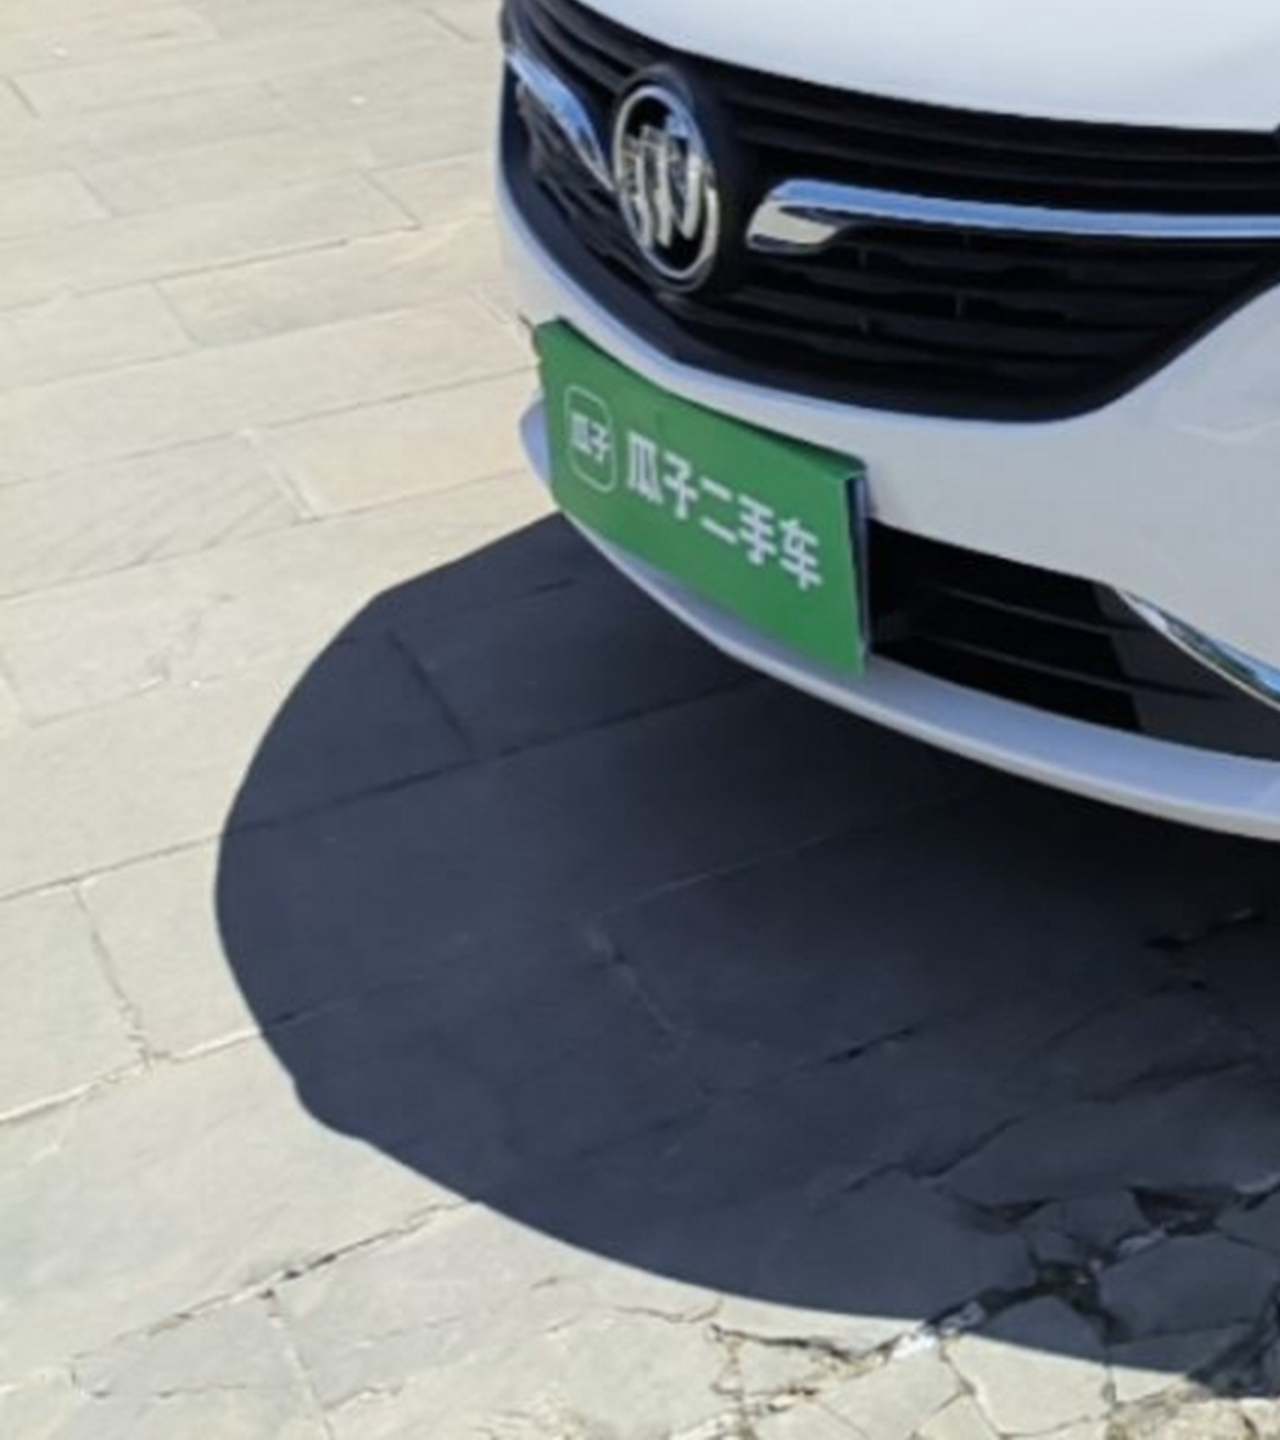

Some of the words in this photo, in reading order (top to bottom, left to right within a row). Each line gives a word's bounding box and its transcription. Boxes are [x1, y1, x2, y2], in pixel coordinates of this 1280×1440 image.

[626, 429, 823, 591] 瓜子二手车
